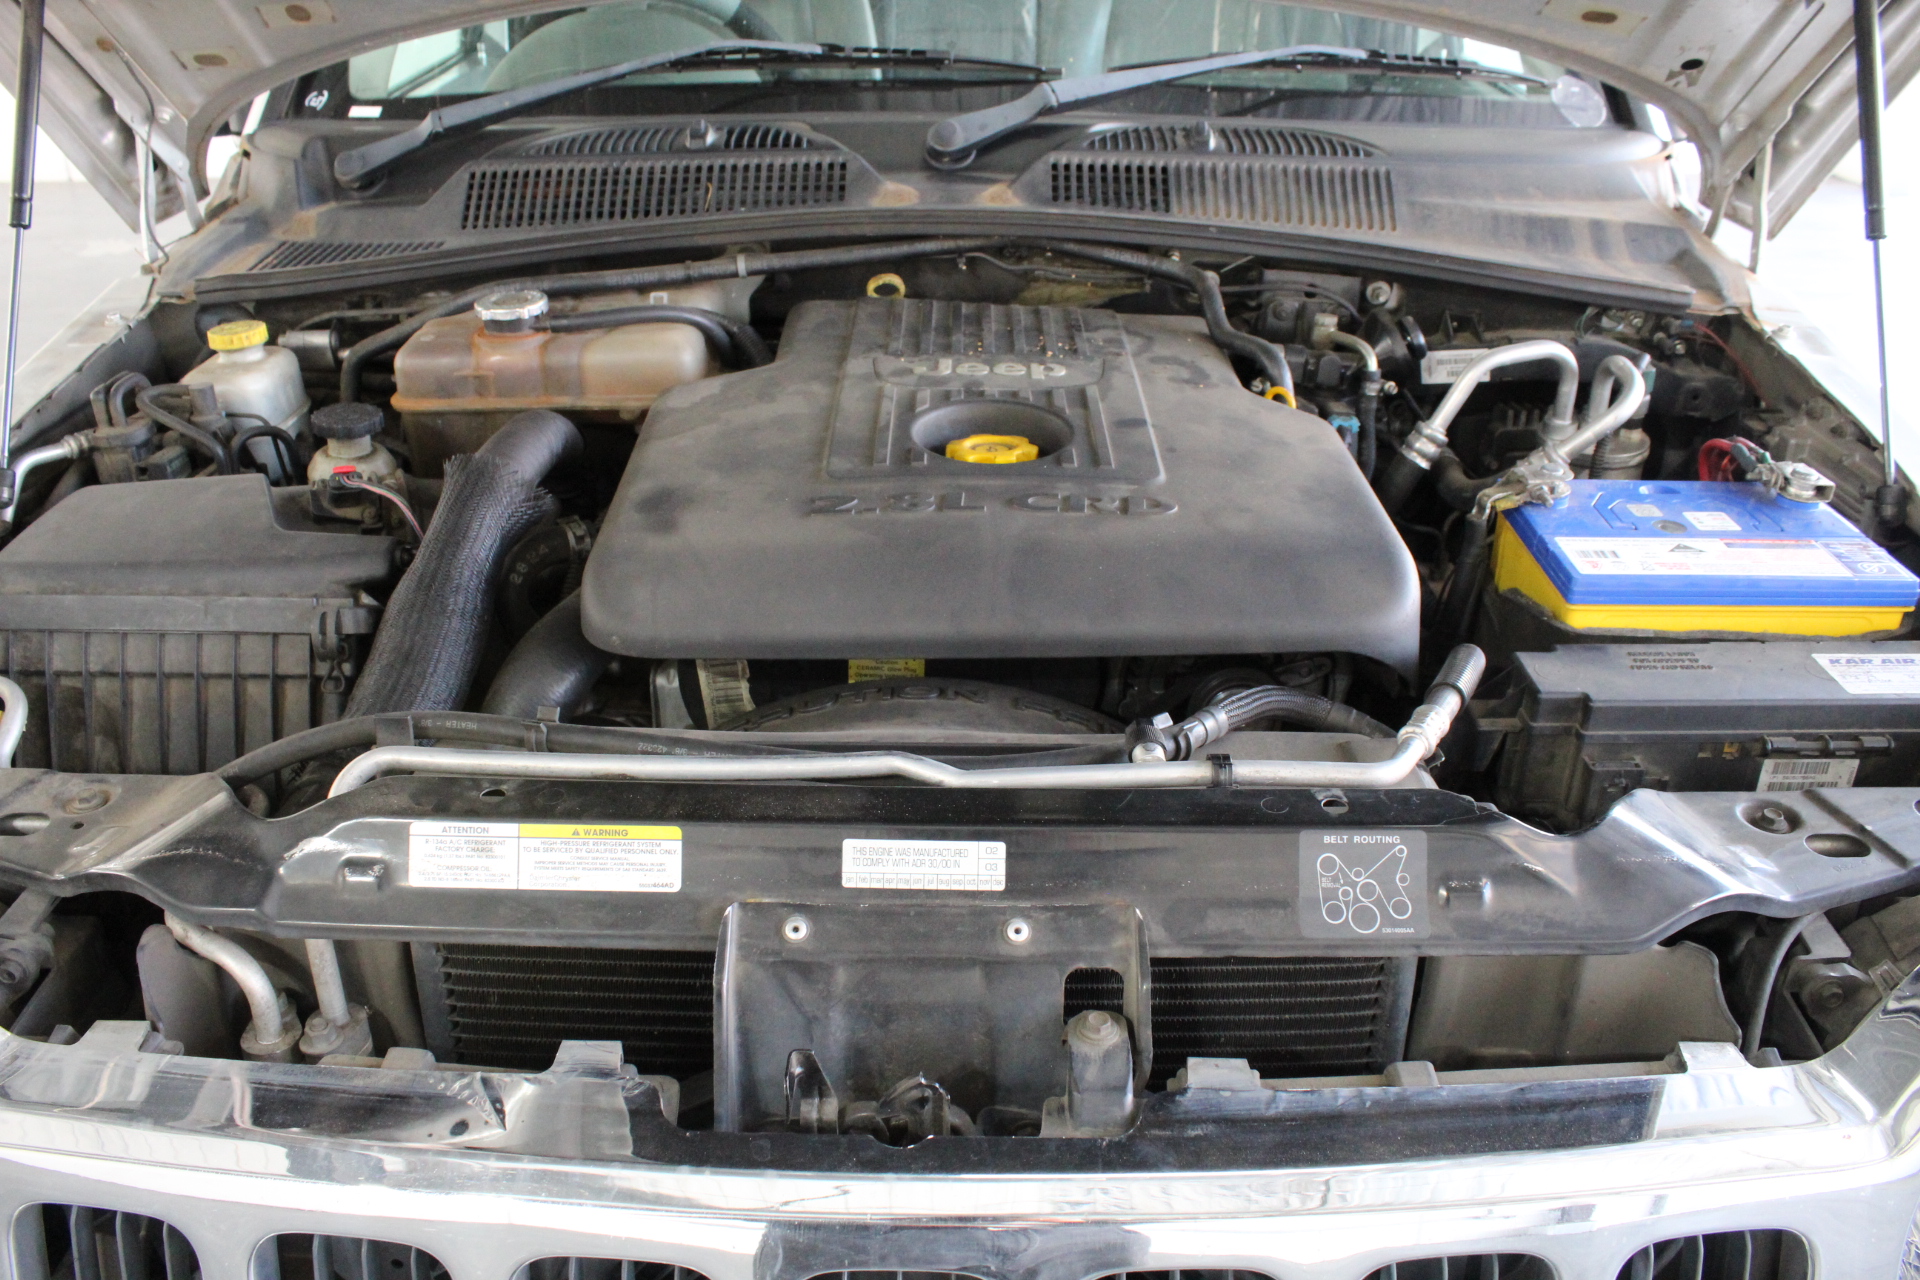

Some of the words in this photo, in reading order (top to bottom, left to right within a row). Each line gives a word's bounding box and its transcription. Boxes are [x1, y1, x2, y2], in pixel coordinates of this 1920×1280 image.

[913, 358, 1067, 380] Jeep
[807, 493, 987, 516] 2.8L
[1013, 493, 1179, 515] CRD
[445, 720, 477, 730] HEATER
[442, 826, 489, 834] ATTENTION
[583, 829, 628, 837] WARNING
[852, 846, 867, 856] THIS
[869, 847, 893, 856] ENGINE
[895, 847, 911, 856] WAS
[913, 848, 969, 857] MANUFACTURED
[852, 858, 860, 866] TO
[862, 858, 890, 867] COMPLY
[892, 858, 910, 867] WITH
[911, 859, 926, 868] ADR
[953, 859, 960, 868] IN
[529, 874, 581, 882] DaimlerChrysler
[885, 876, 895, 885] apr
[898, 877, 910, 885] may
[939, 877, 949, 886] aug
[952, 878, 963, 886] sep
[993, 878, 1004, 886] dec
